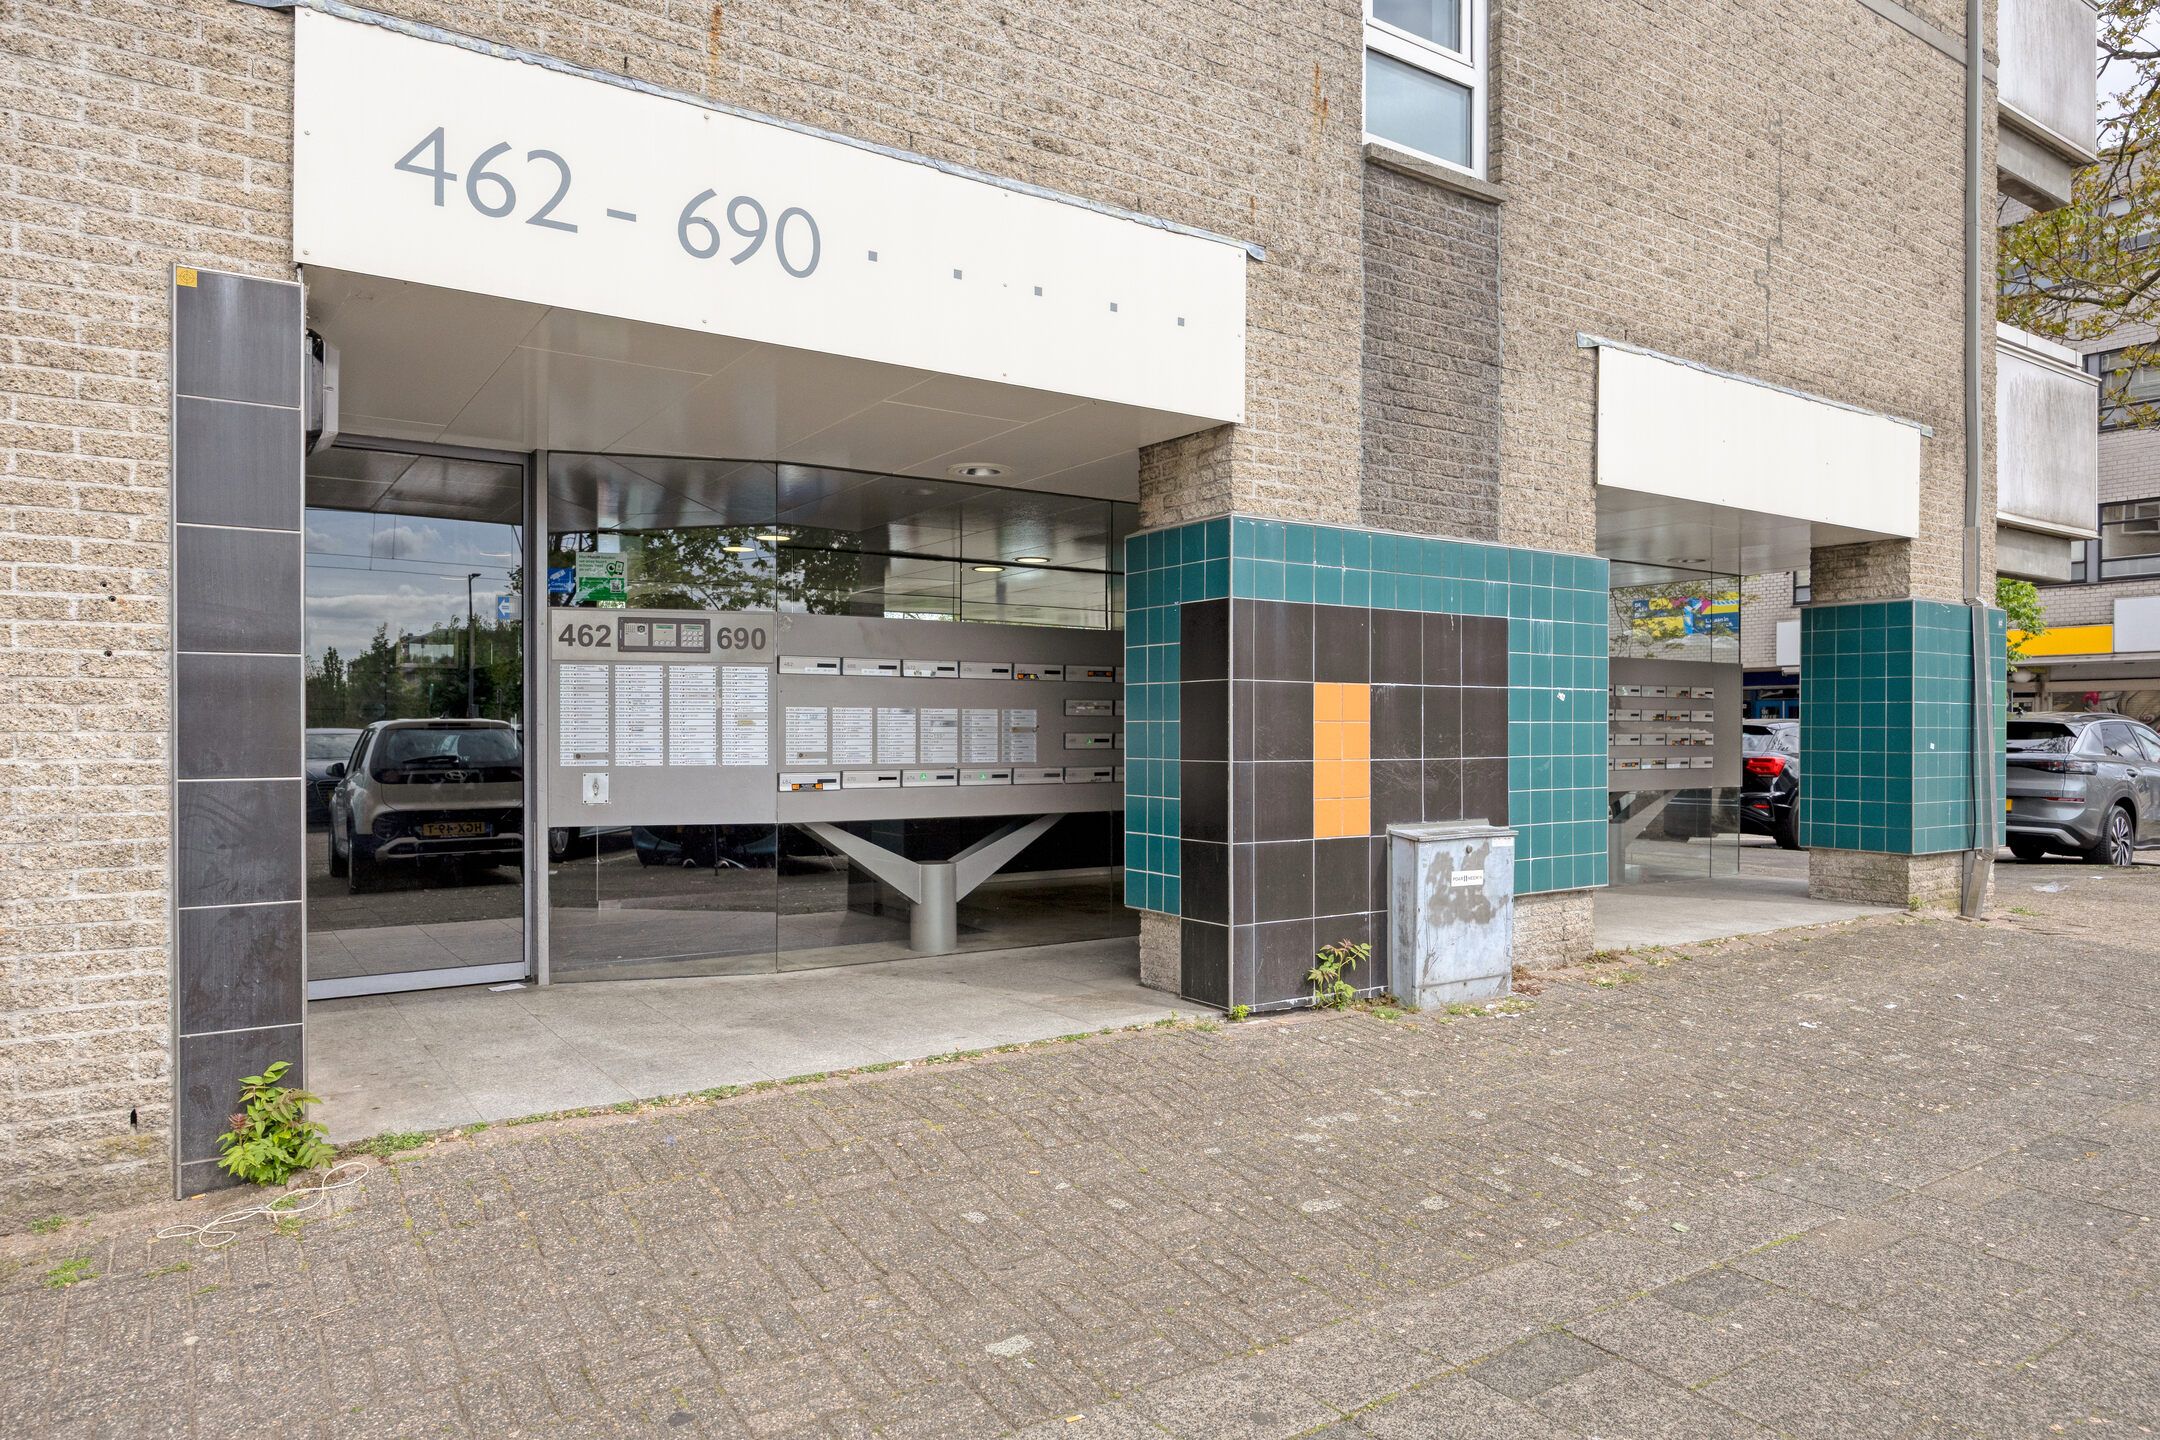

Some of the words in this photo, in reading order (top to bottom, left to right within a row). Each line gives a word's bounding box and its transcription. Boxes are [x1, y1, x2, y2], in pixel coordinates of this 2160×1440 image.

[395, 127, 577, 233] 462
[678, 189, 820, 278] 690
[559, 624, 611, 647] 462
[717, 627, 766, 650] 690
